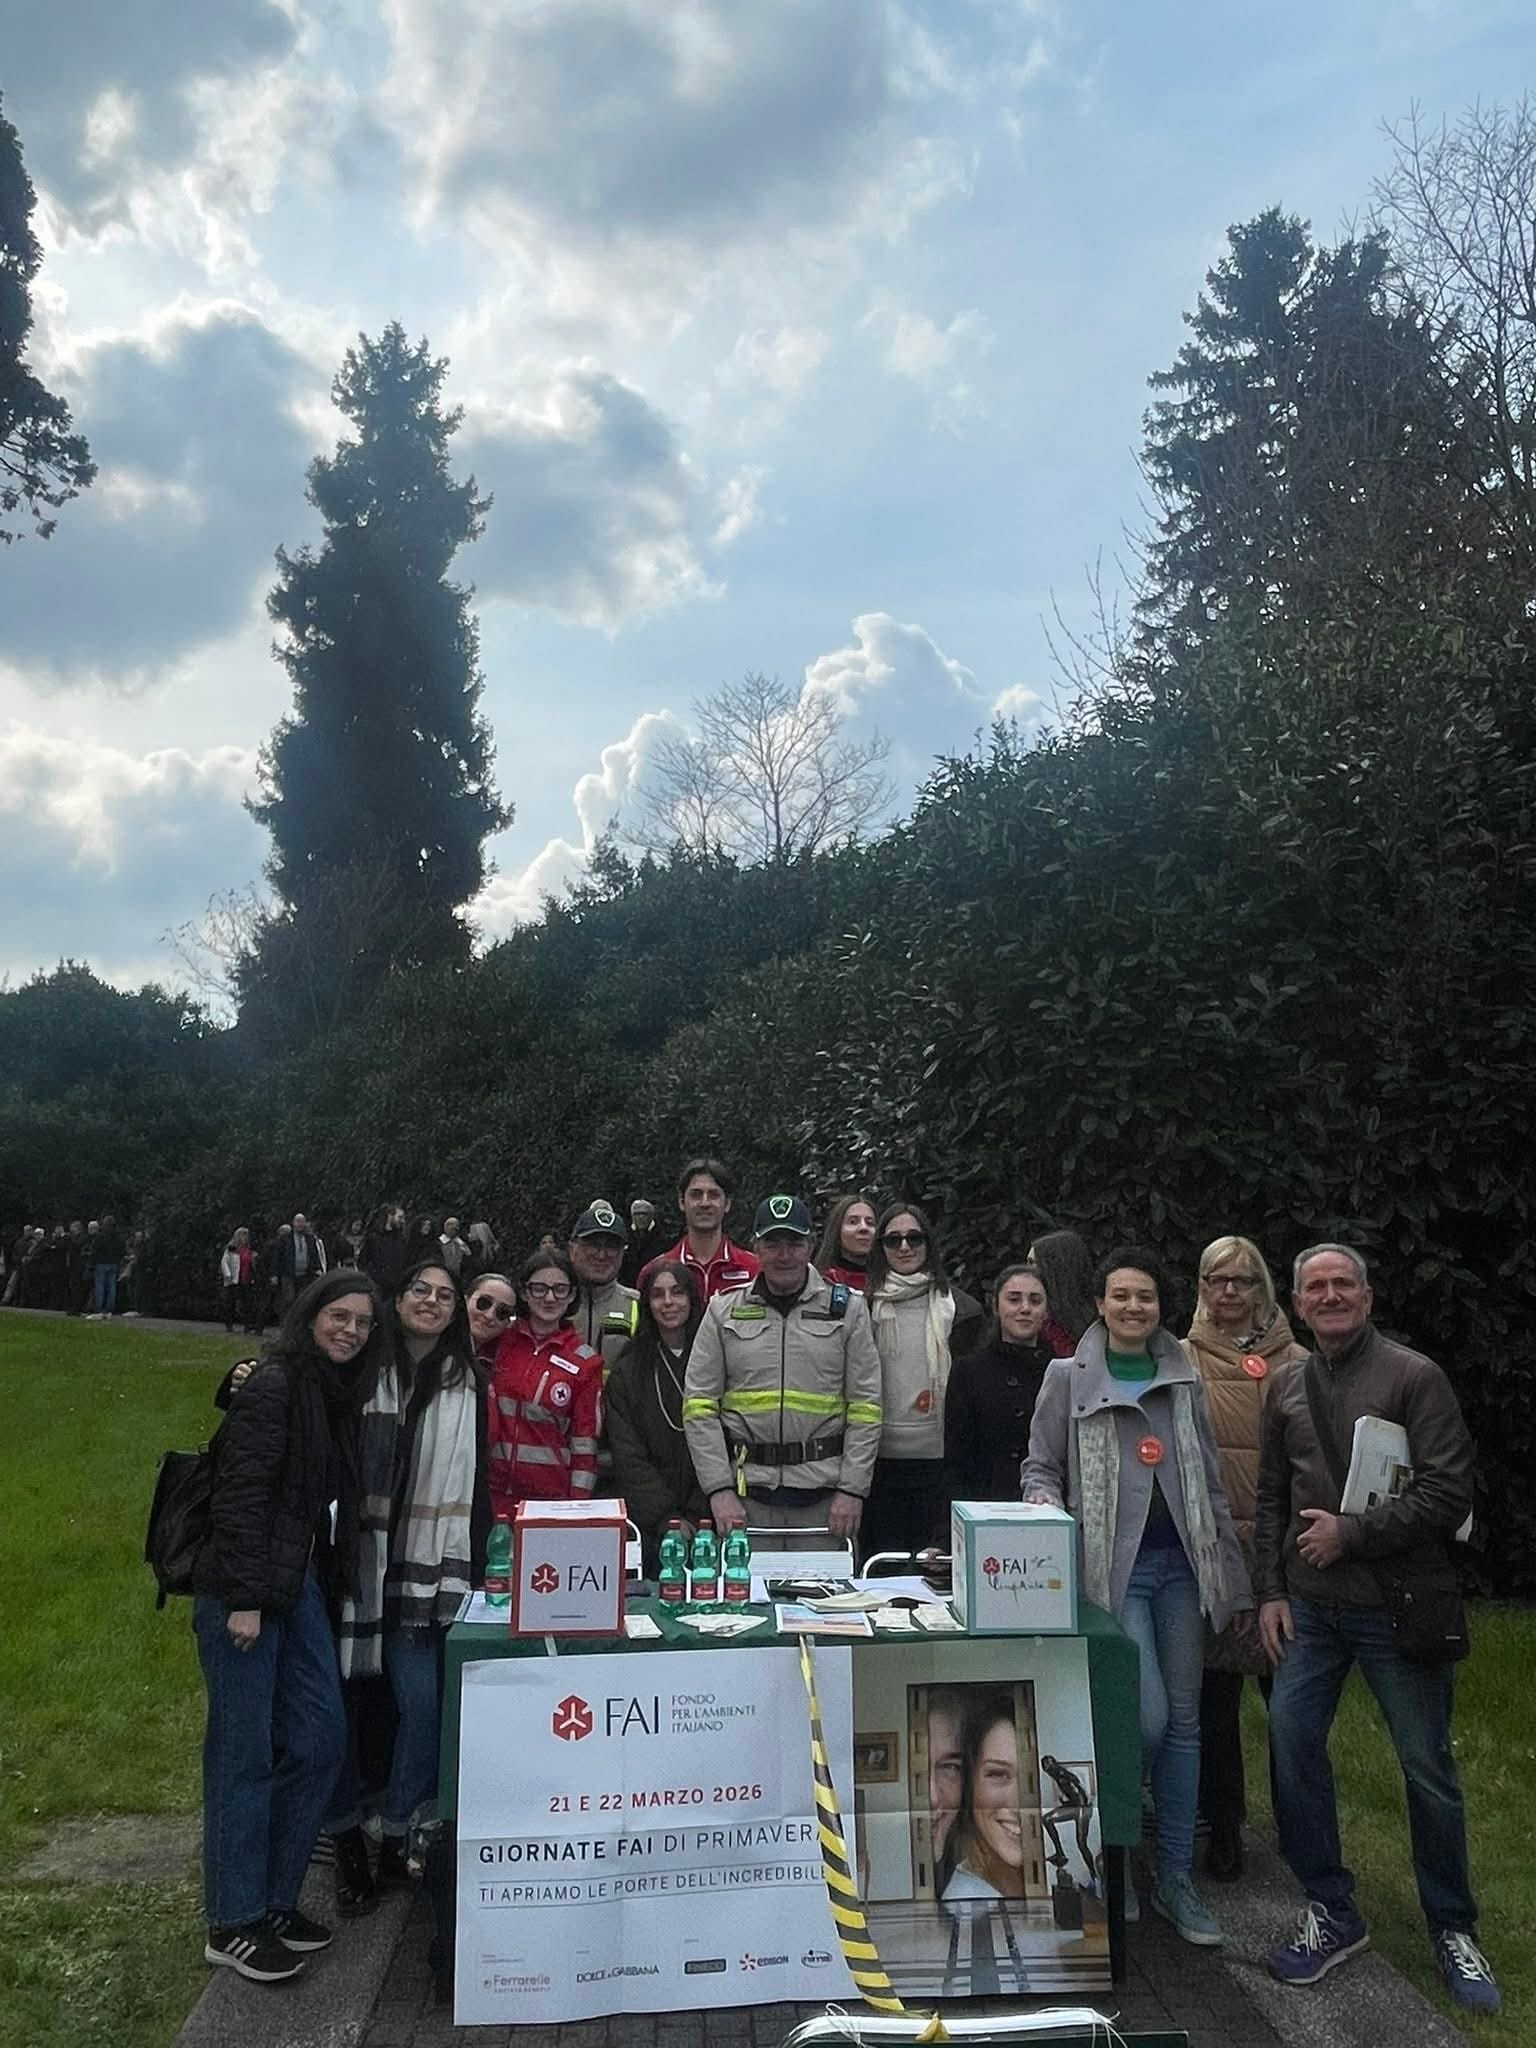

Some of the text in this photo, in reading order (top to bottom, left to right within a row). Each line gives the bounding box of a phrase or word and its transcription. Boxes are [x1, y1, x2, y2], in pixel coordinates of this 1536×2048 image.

[568, 1565, 606, 1592] FAI
[1002, 1558, 1027, 1575] FAI
[671, 1693, 716, 1706] FONDO
[671, 1704, 757, 1720] PER L'AMBIENTE
[606, 1695, 659, 1736] FAI
[671, 1720, 724, 1734] ITALIANO
[549, 1783, 762, 1812] 21 E 22 MARZO 2026
[479, 1823, 820, 1863] GIORNATE FAI DI PRIMAVER
[479, 1887, 494, 1902] TI
[500, 1886, 581, 1902] APRIAMO
[588, 1882, 608, 1898] LE
[614, 1874, 669, 1895] PORTE
